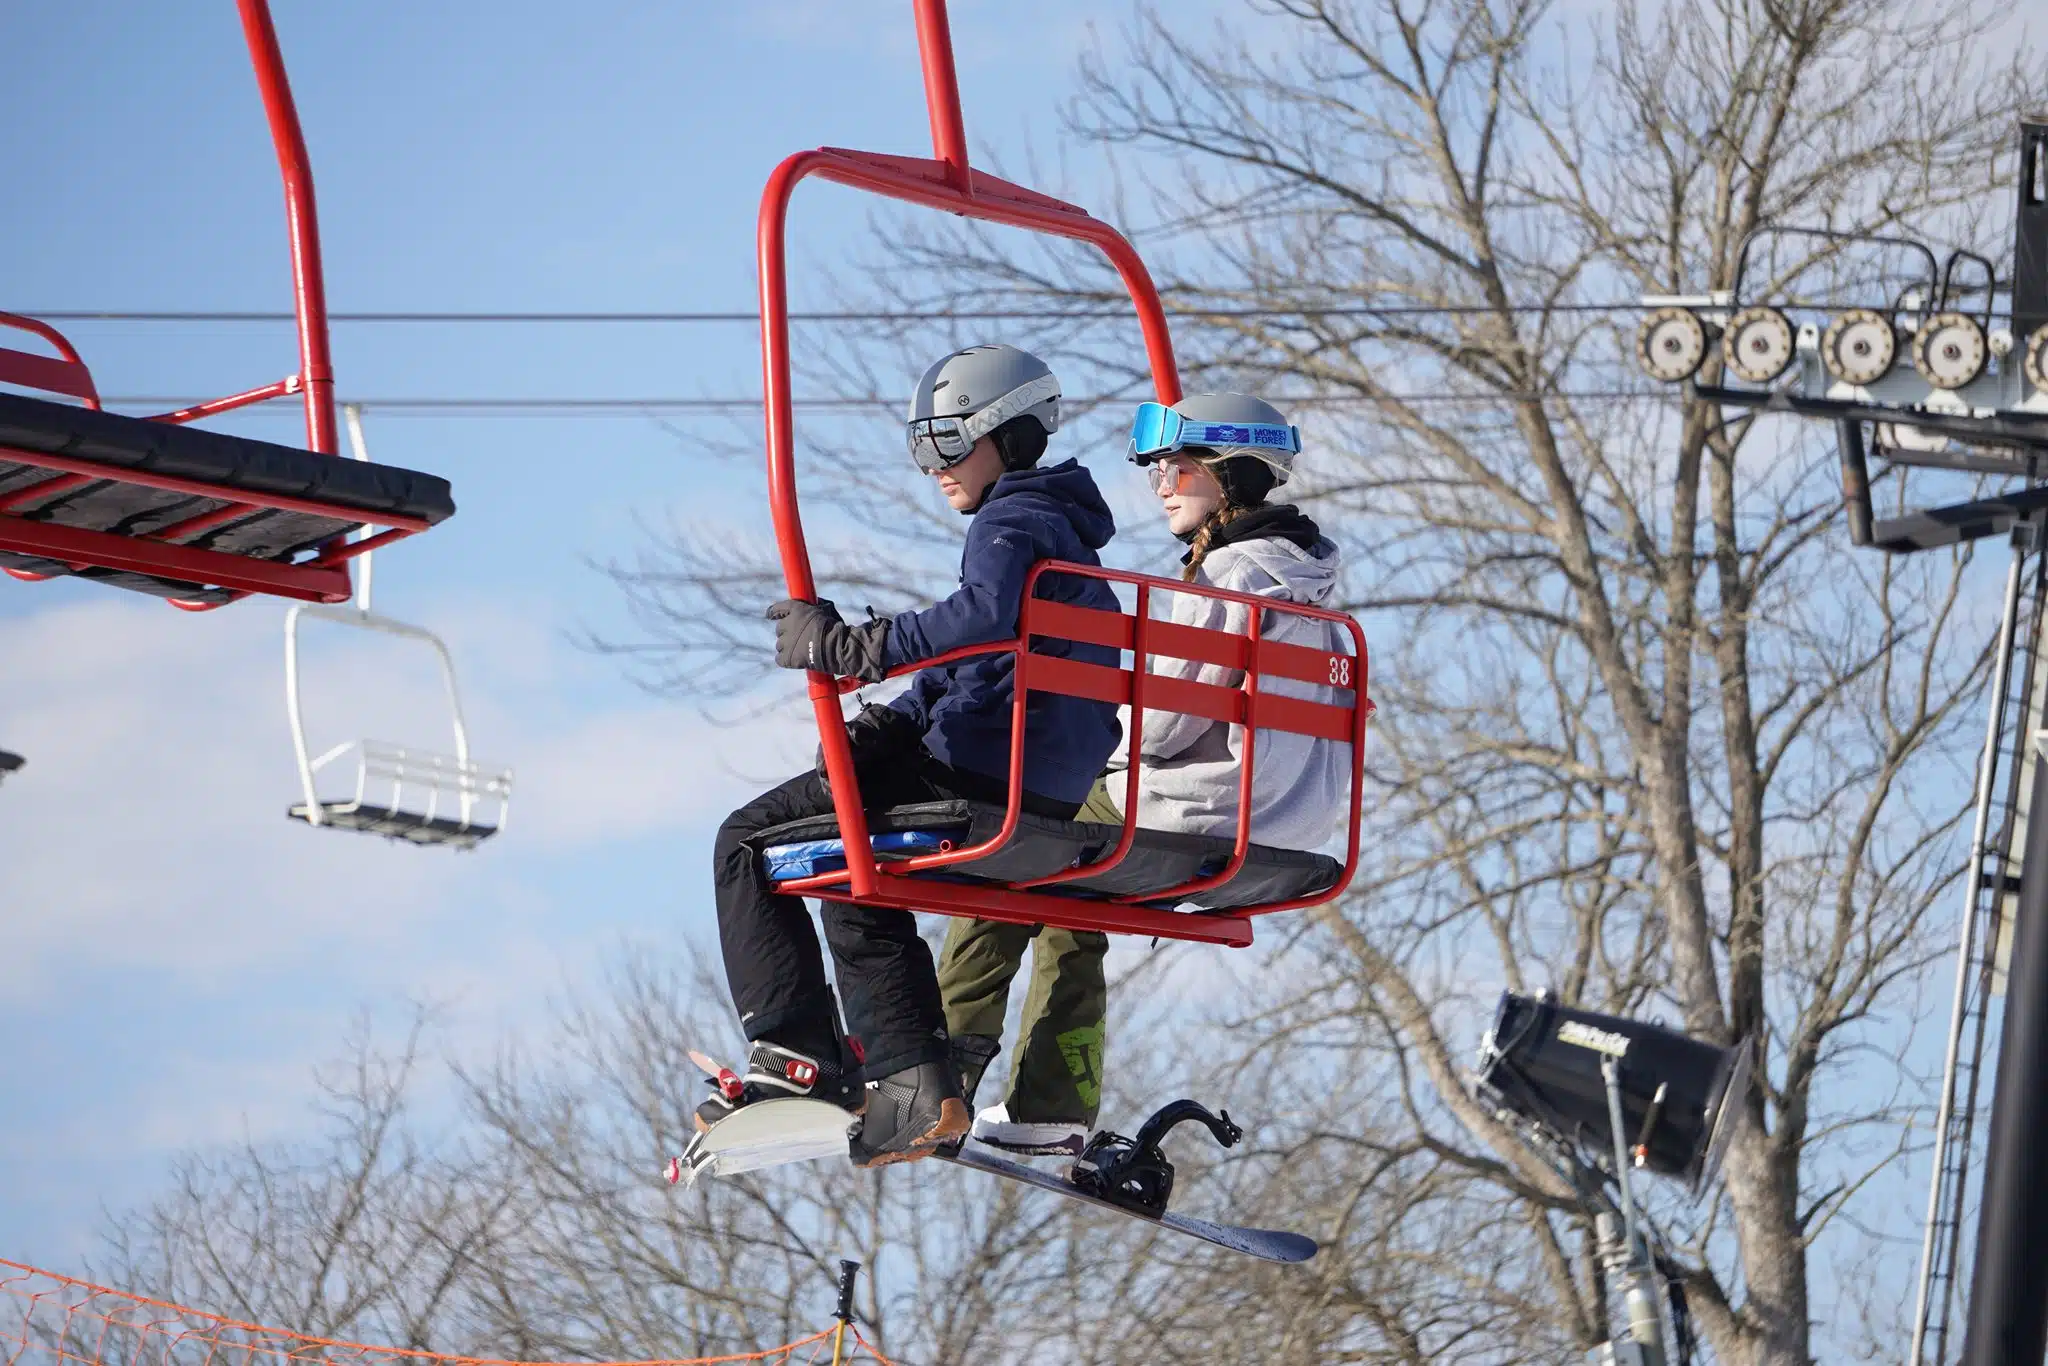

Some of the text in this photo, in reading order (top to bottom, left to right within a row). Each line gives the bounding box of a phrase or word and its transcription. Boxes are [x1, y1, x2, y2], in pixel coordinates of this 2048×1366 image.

[1254, 428, 1287, 438] MONKEY
[1254, 436, 1287, 446] FOREST
[1329, 656, 1350, 686] 38
